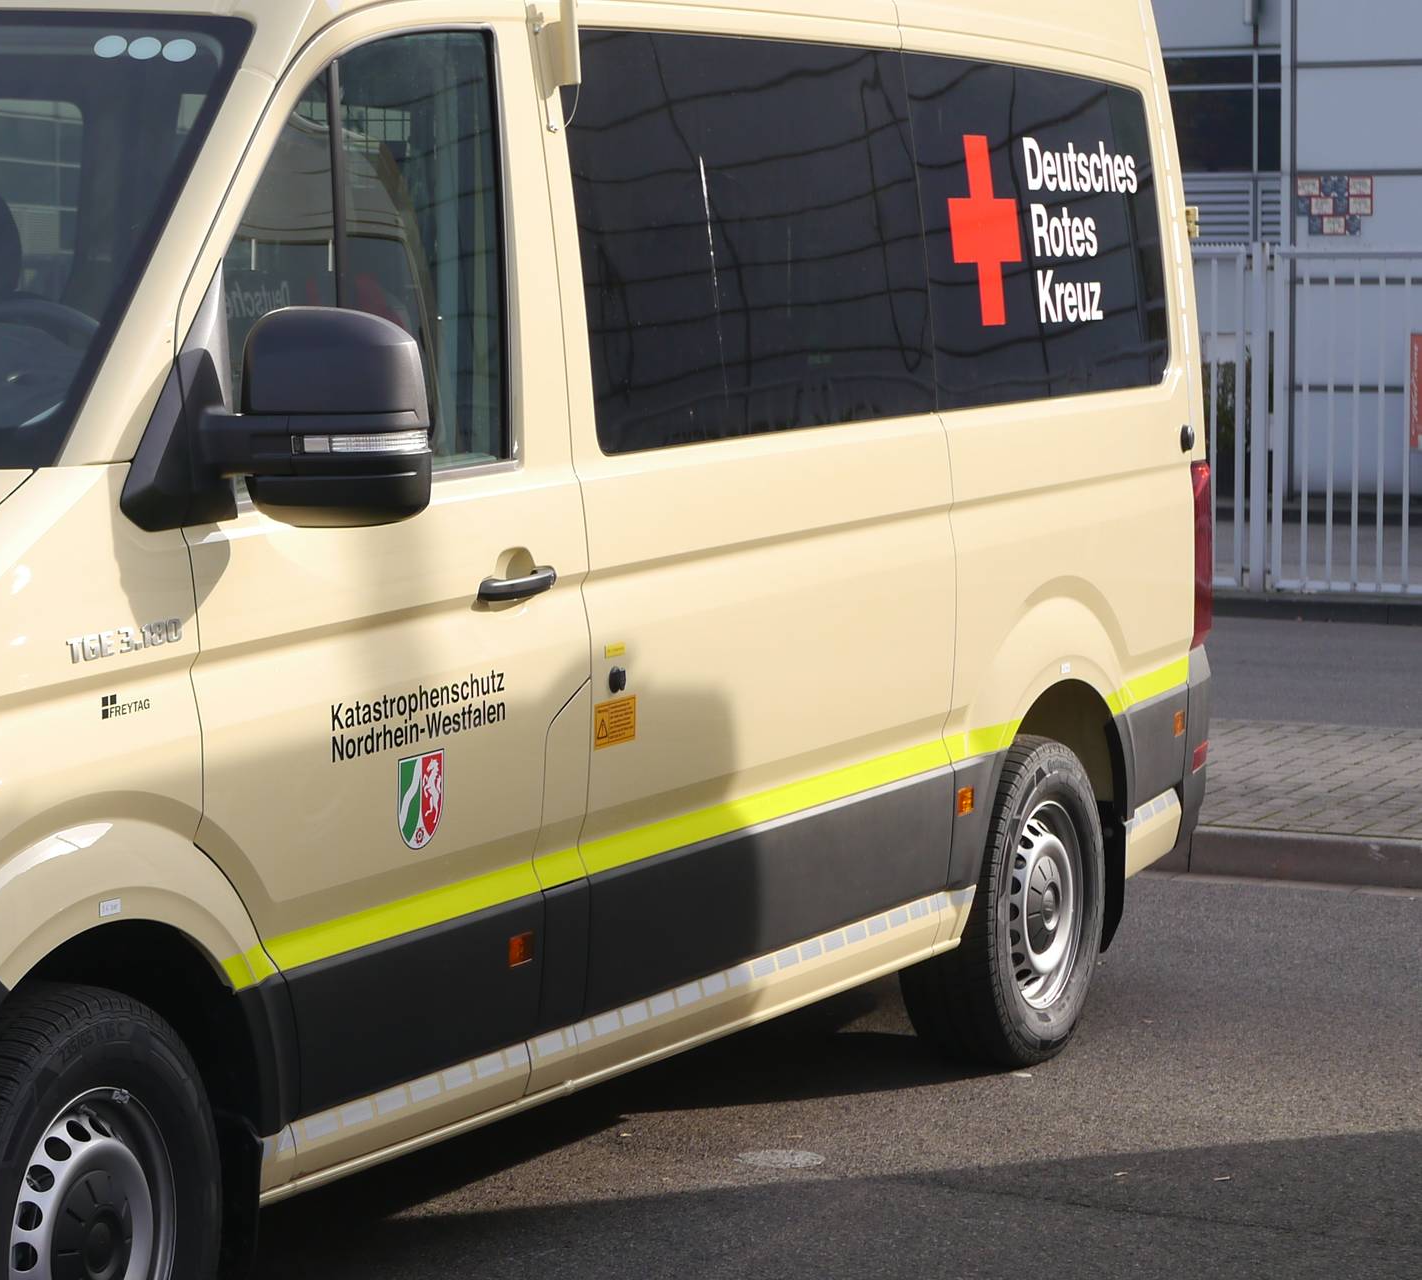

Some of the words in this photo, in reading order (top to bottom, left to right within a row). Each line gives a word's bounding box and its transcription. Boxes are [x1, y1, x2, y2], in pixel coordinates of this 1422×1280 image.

[1022, 136, 1138, 194] Deutsches
[1030, 203, 1098, 257] Rotes
[1036, 269, 1104, 323] Kreuz
[66, 629, 115, 664] TGE
[117, 618, 182, 654] 3.180
[109, 698, 151, 718] FREYTAG
[331, 669, 505, 732] Katastrophenschutz
[331, 700, 506, 763] Nordrhein-Westfalen
